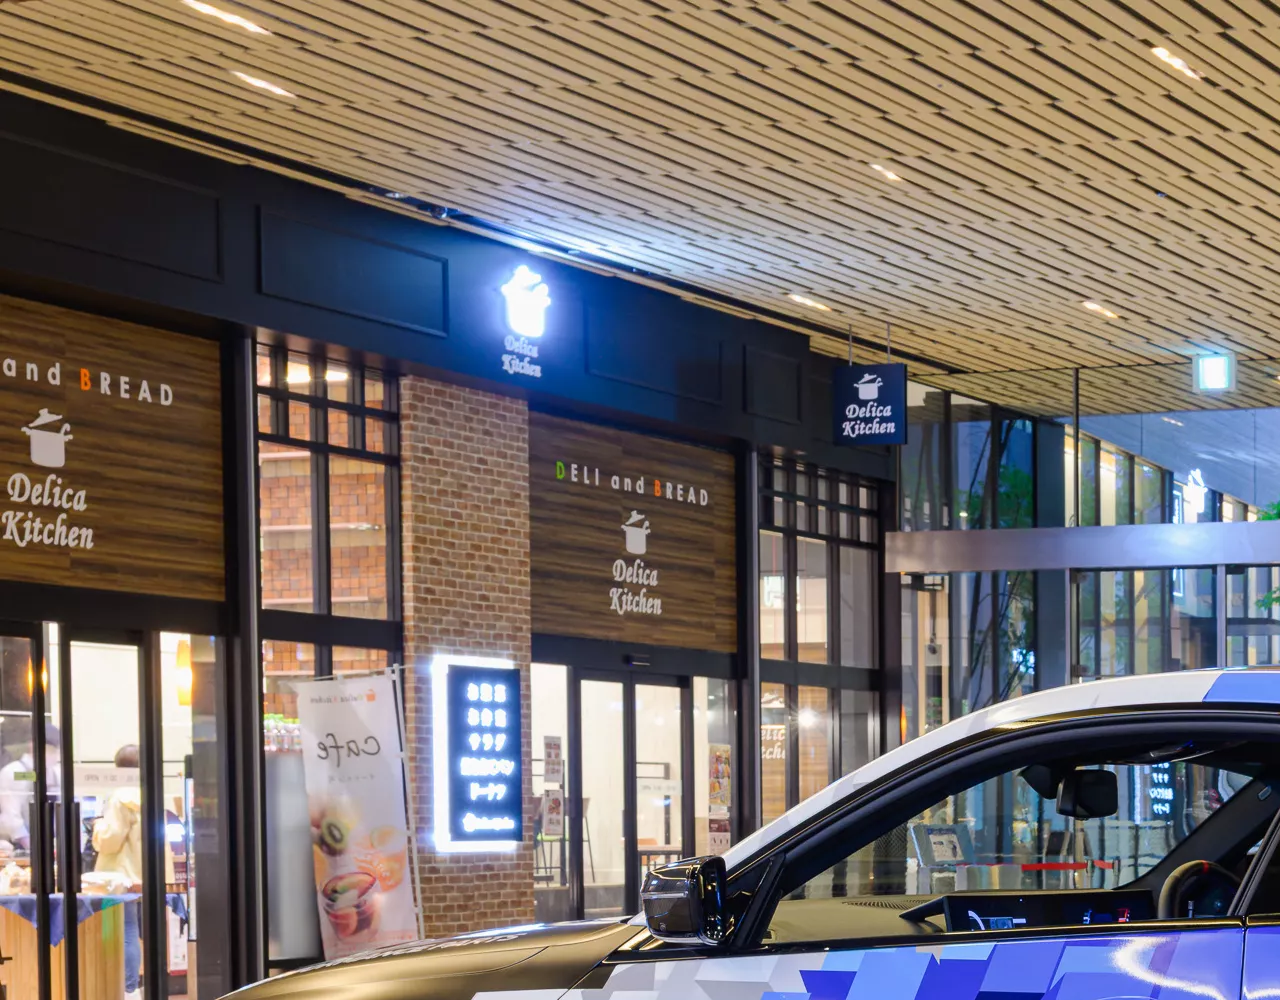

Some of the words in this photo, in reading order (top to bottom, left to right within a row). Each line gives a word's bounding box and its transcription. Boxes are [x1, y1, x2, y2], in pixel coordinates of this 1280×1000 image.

[2, 357, 61, 386] and
[79, 367, 173, 406] BREAD
[845, 401, 892, 418] Delica
[842, 418, 895, 437] Kitchen
[6, 473, 87, 511] Delica
[555, 461, 599, 486] DELI
[610, 475, 645, 494] and
[654, 479, 708, 506] BREAD
[1, 510, 94, 550] Kitchen
[612, 559, 658, 586] Delica
[609, 587, 662, 615] Kitchen
